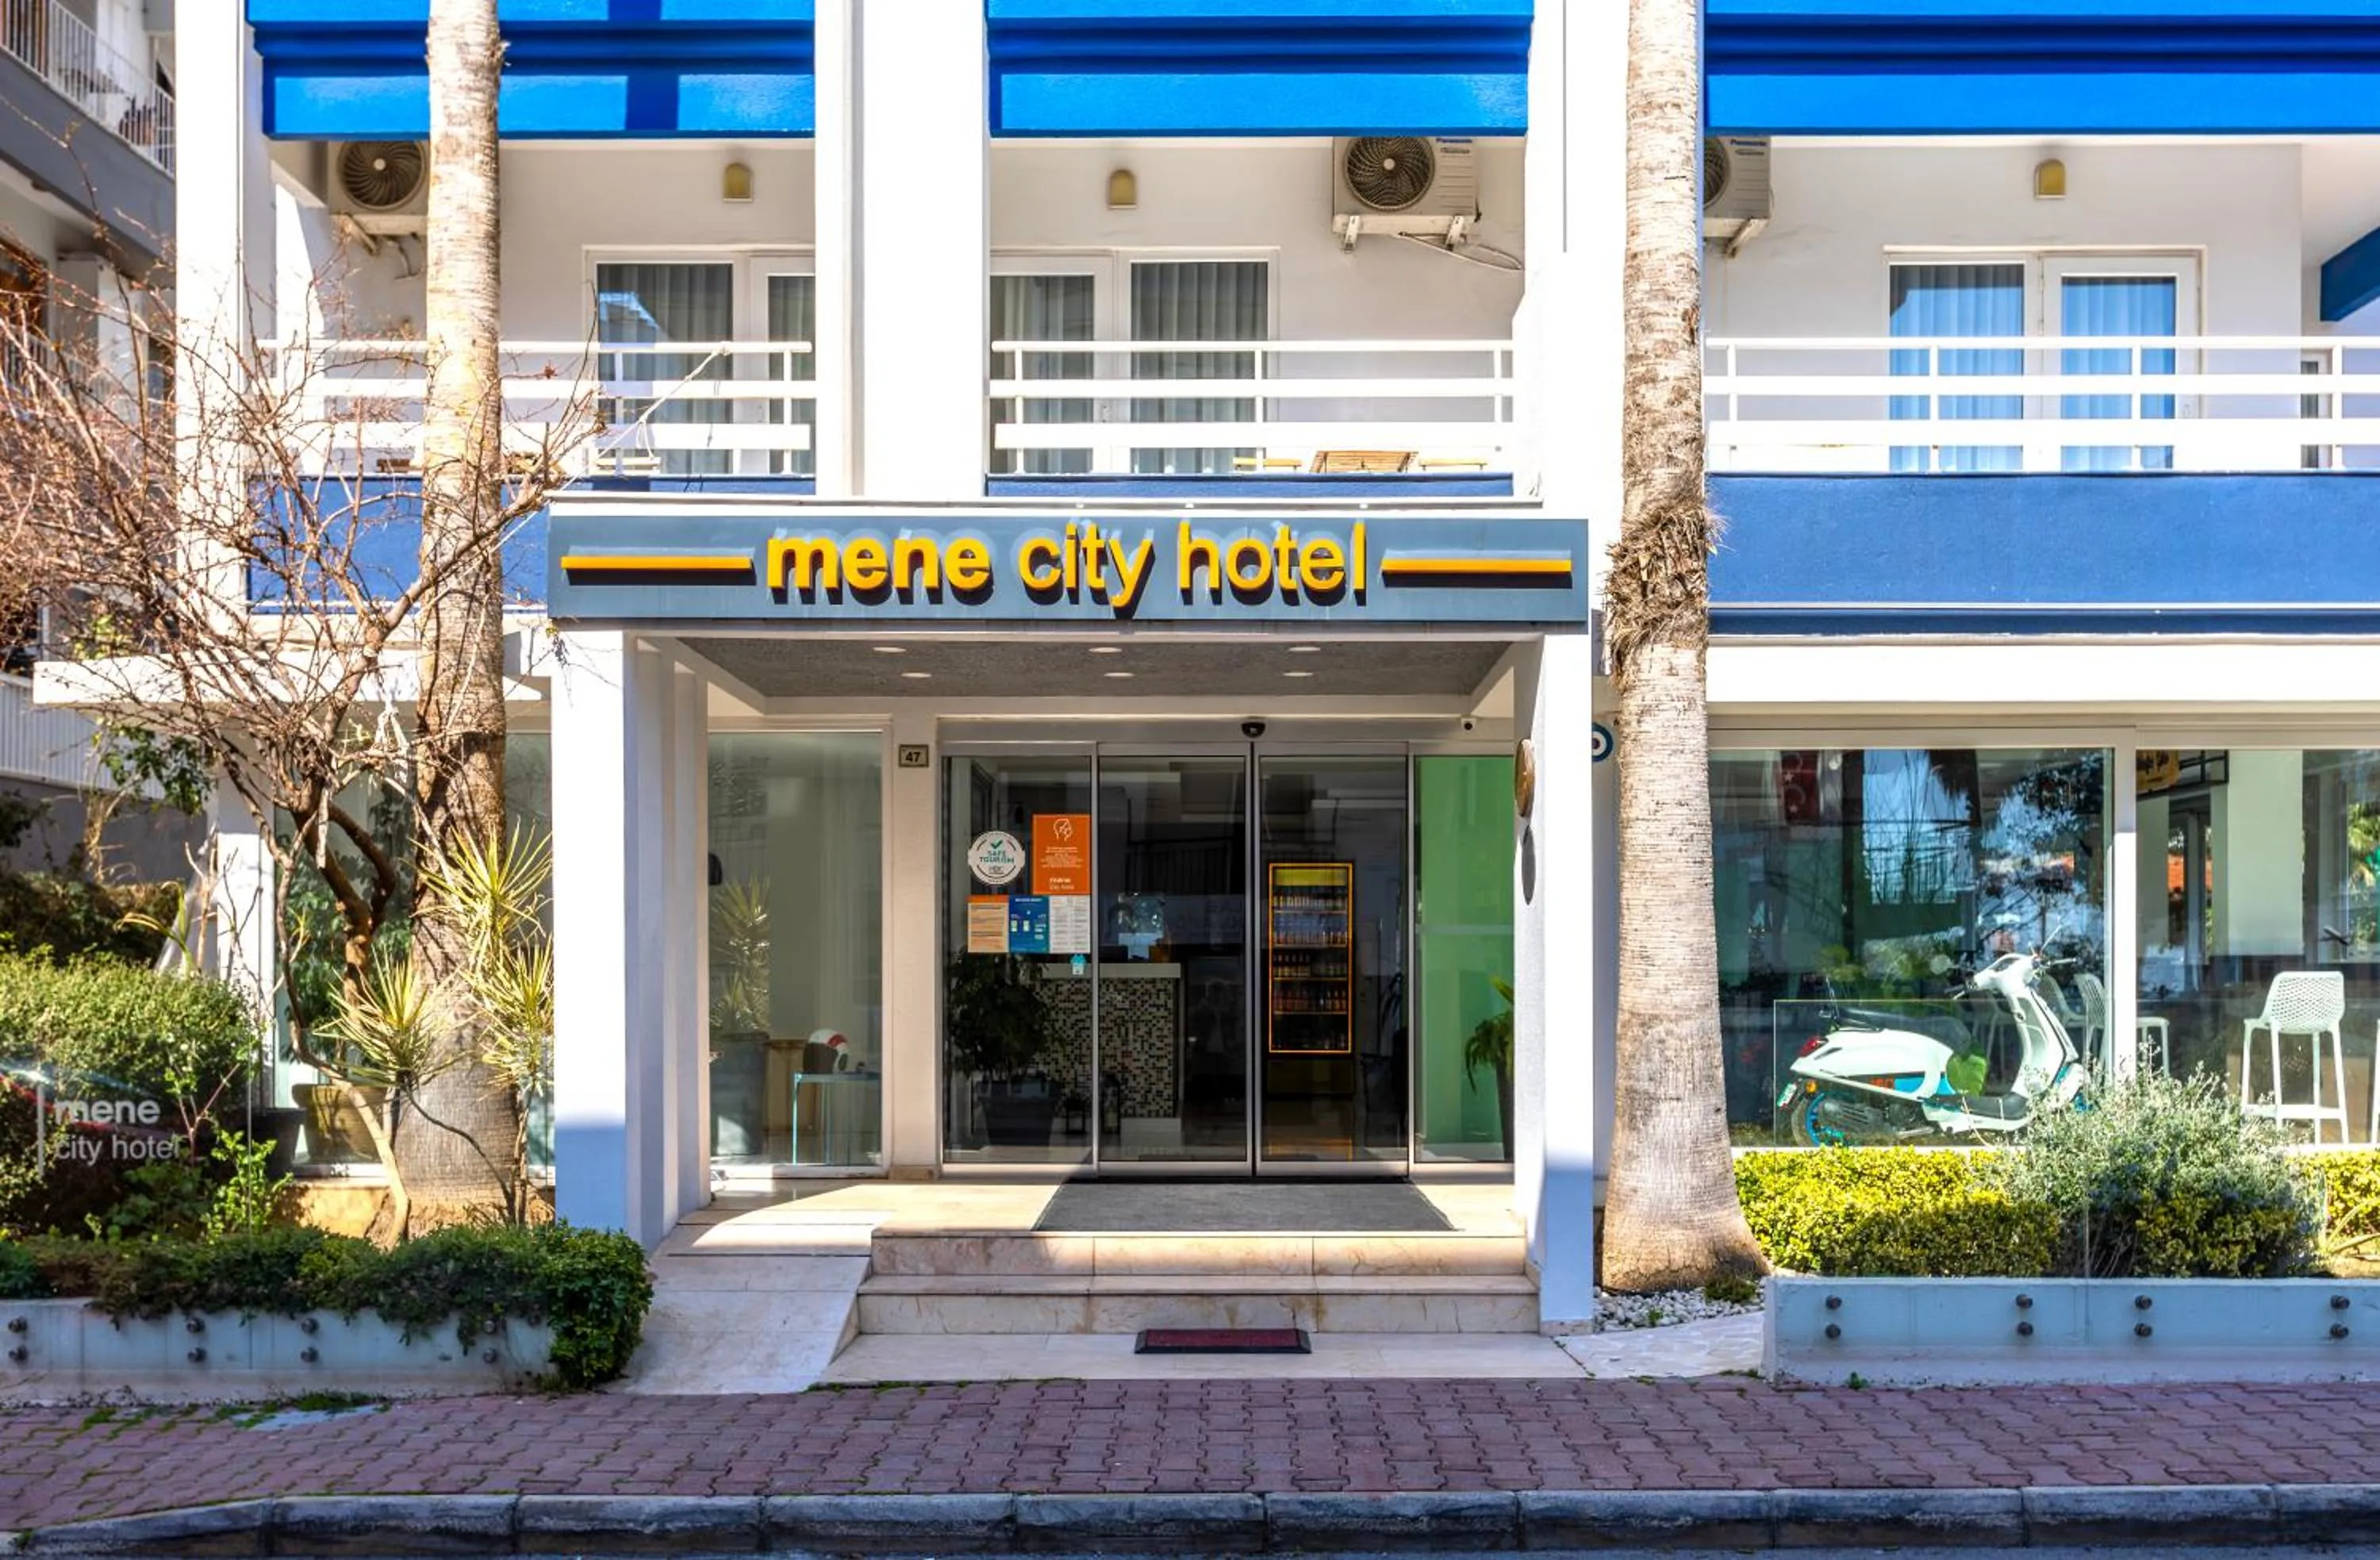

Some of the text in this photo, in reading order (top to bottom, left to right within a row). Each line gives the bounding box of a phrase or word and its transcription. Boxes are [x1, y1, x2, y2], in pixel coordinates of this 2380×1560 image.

[766, 520, 1367, 608] mene city hotel
[905, 751, 920, 763] 47
[52, 1099, 161, 1125] mene
[54, 1134, 179, 1167] city hotel
